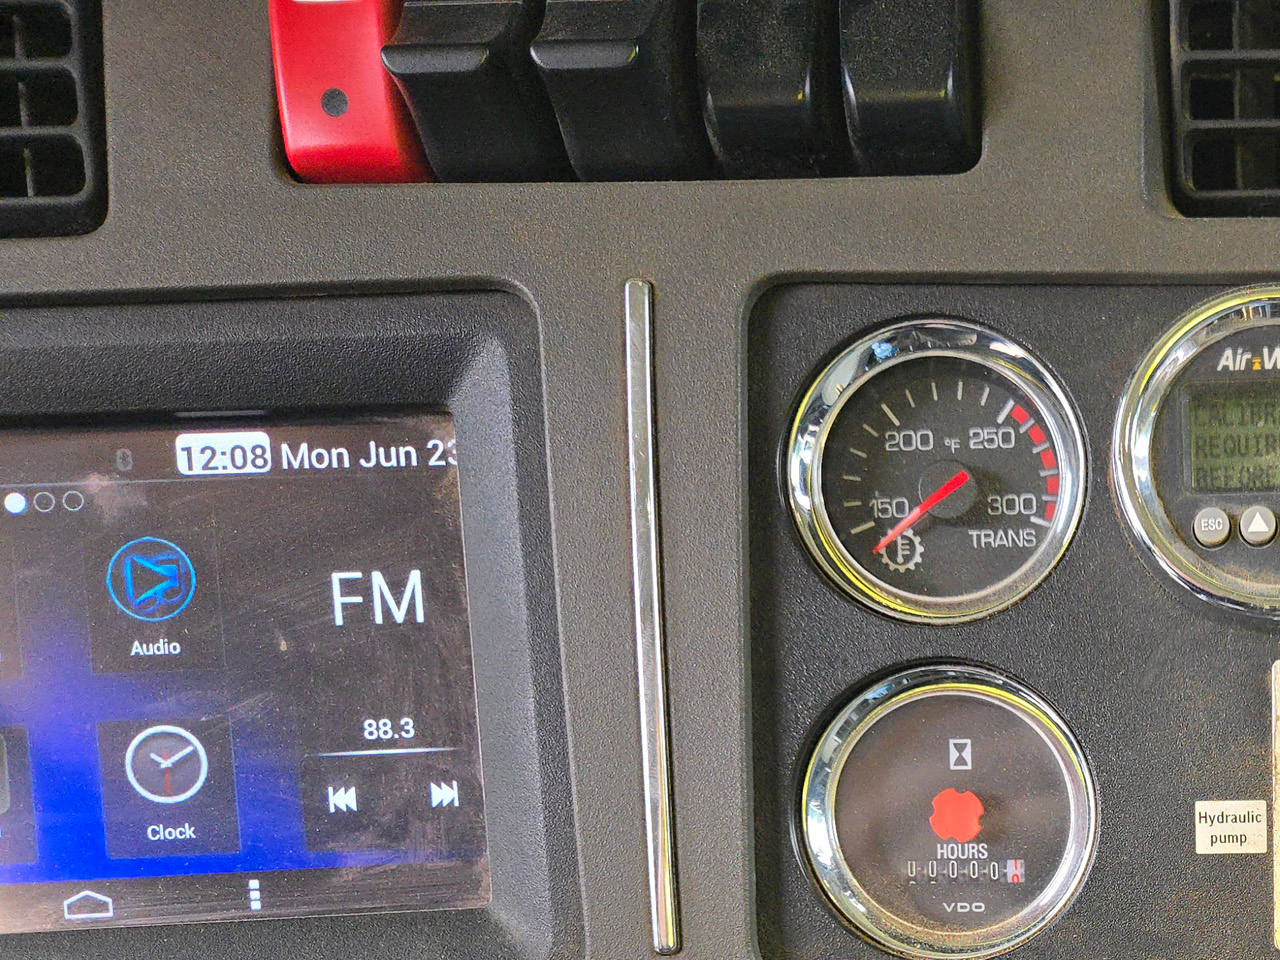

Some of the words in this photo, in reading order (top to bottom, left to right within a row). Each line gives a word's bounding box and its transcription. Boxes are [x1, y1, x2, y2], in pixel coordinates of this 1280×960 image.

[885, 430, 934, 451] 200
[969, 427, 1015, 448] 250
[181, 444, 269, 472] 12:08
[281, 443, 350, 469] Mon
[359, 441, 417, 468] Jun
[869, 497, 909, 518] 150
[987, 493, 1036, 515] 300
[1201, 517, 1223, 530] ESC
[968, 529, 1036, 549] TRANS
[331, 569, 425, 626] FM
[130, 639, 181, 656] Audio
[363, 719, 415, 740] 88.3
[1198, 811, 1262, 827] Hydraulic
[147, 824, 196, 841] Clock
[1210, 833, 1248, 847] pump
[937, 843, 988, 859] HOURS
[943, 902, 985, 913] VDO
